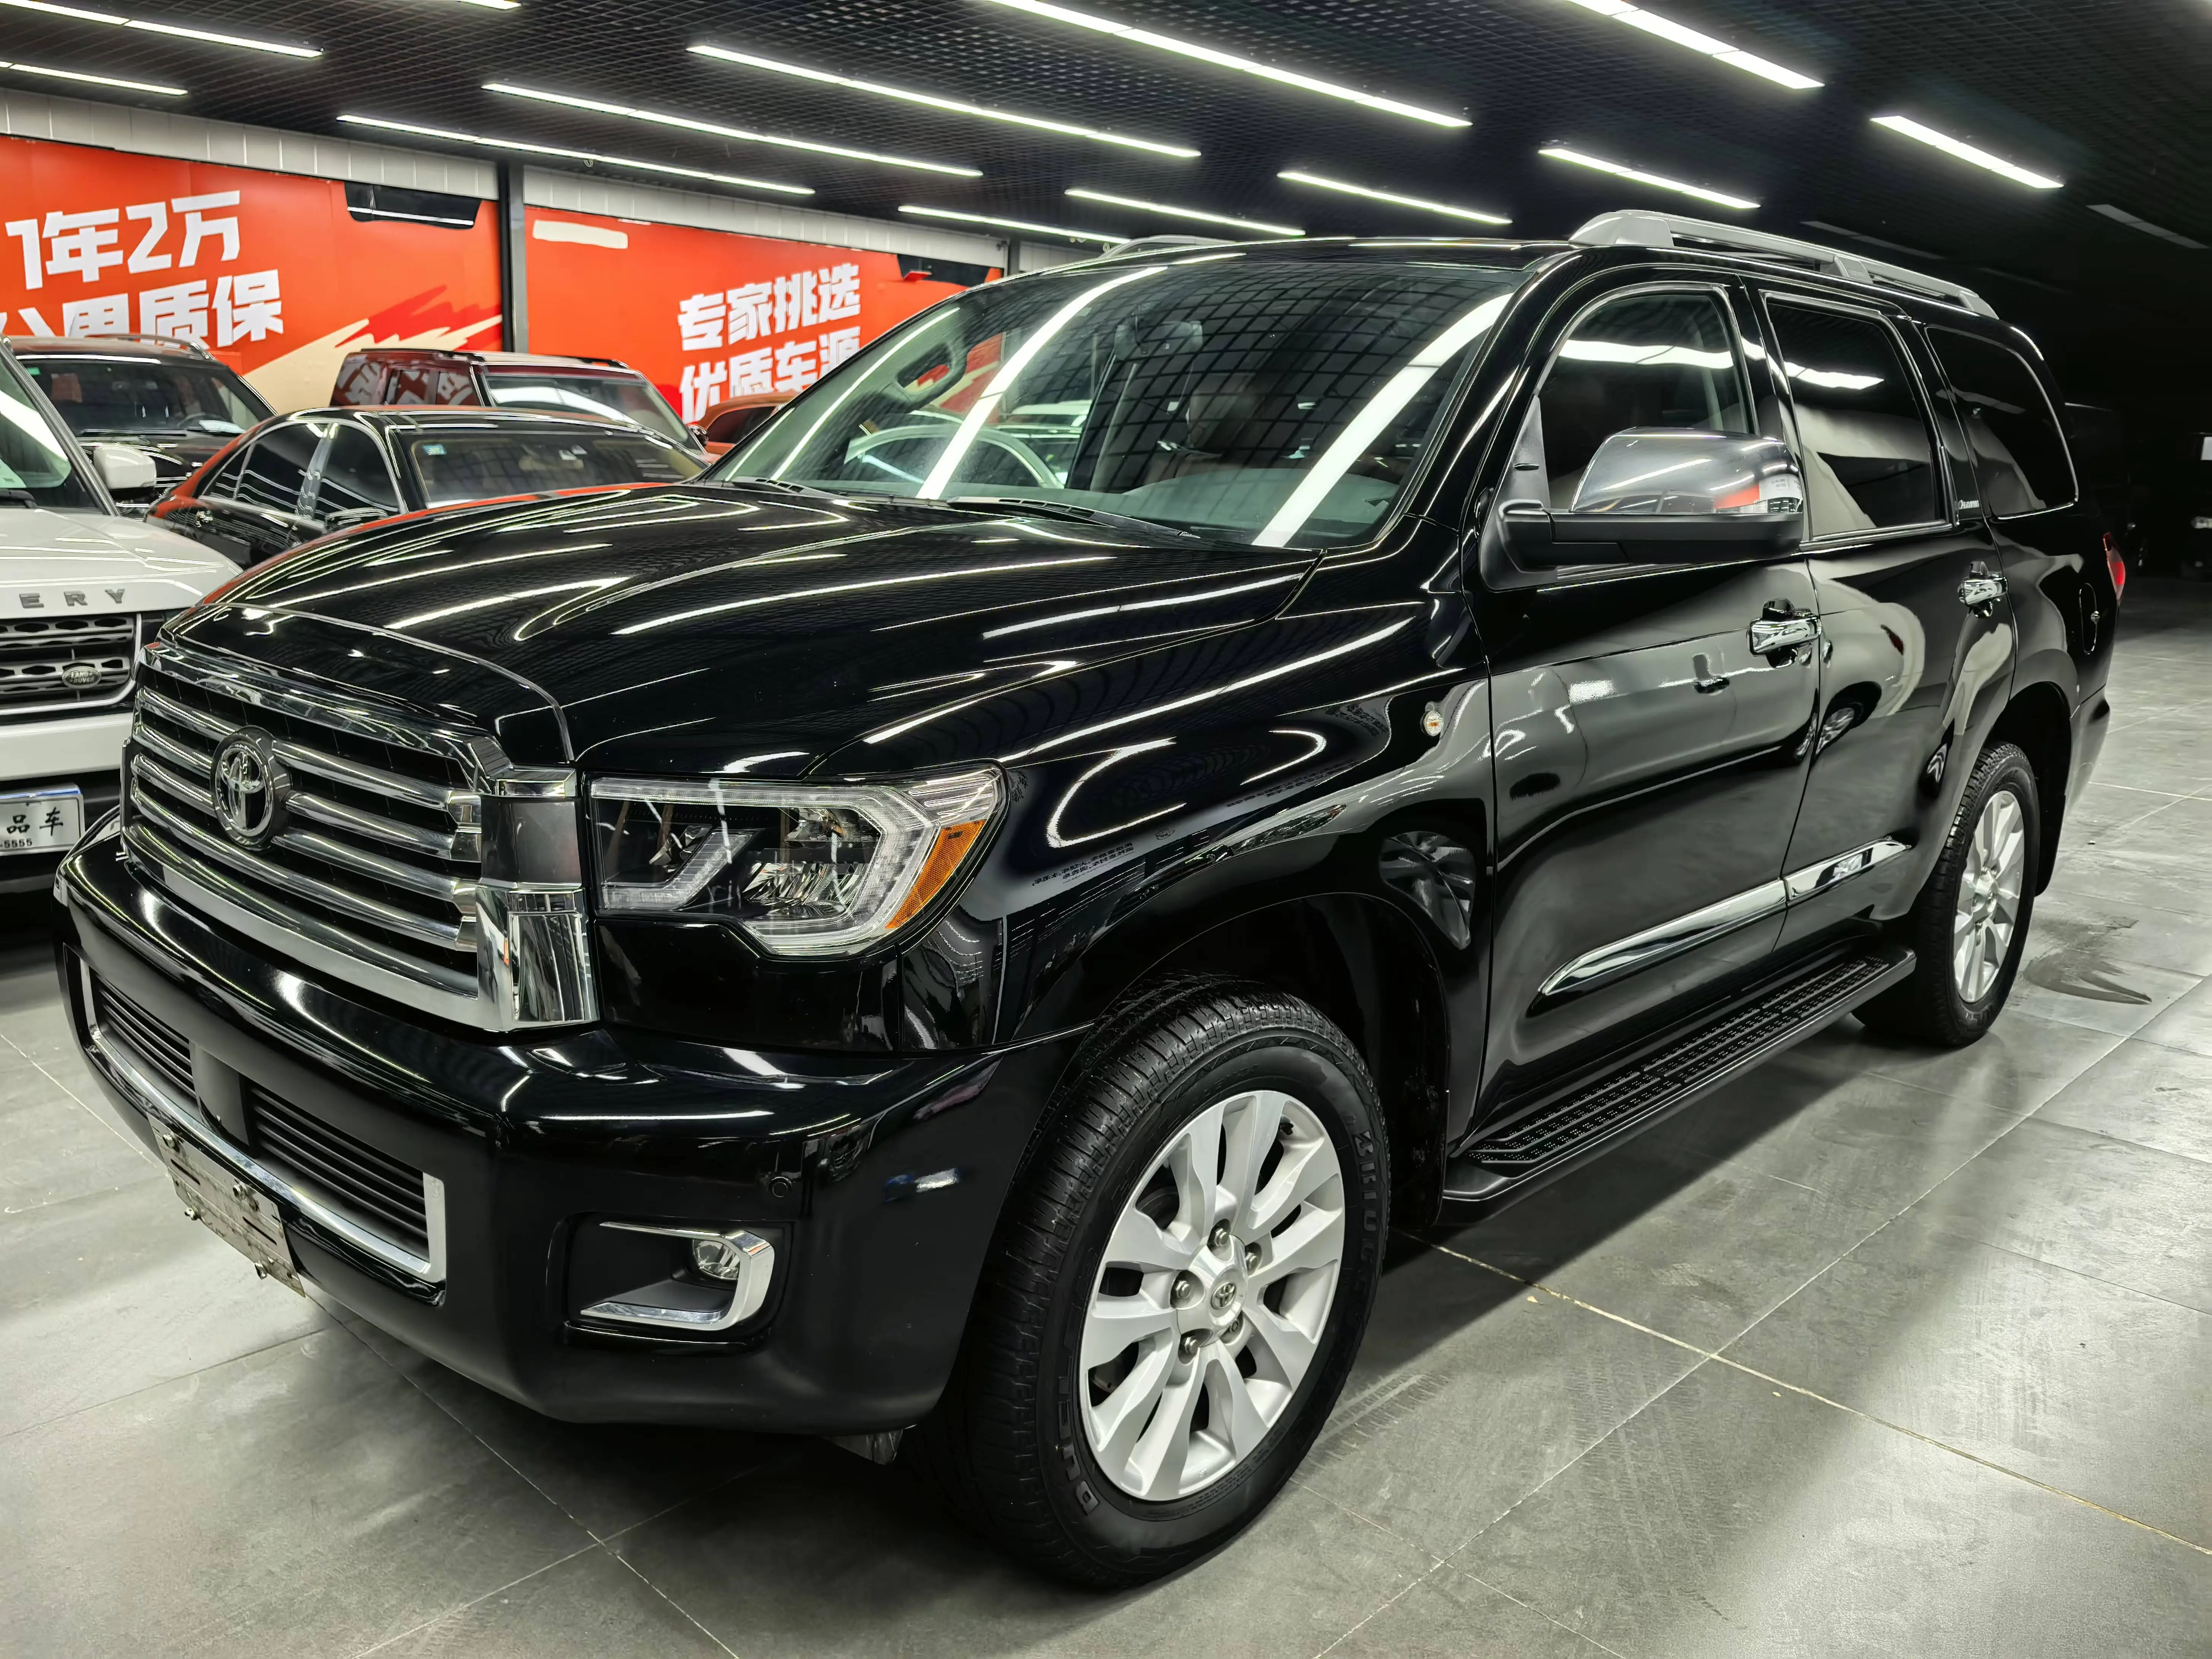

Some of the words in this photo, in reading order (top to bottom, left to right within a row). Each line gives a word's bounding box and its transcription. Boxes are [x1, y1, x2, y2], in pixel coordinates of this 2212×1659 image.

[5, 190, 240, 290] 1年2万
[678, 263, 860, 351] 专家挑选
[679, 326, 860, 424] 优质车源
[19, 588, 125, 608] ERY
[6, 806, 63, 836] 品车
